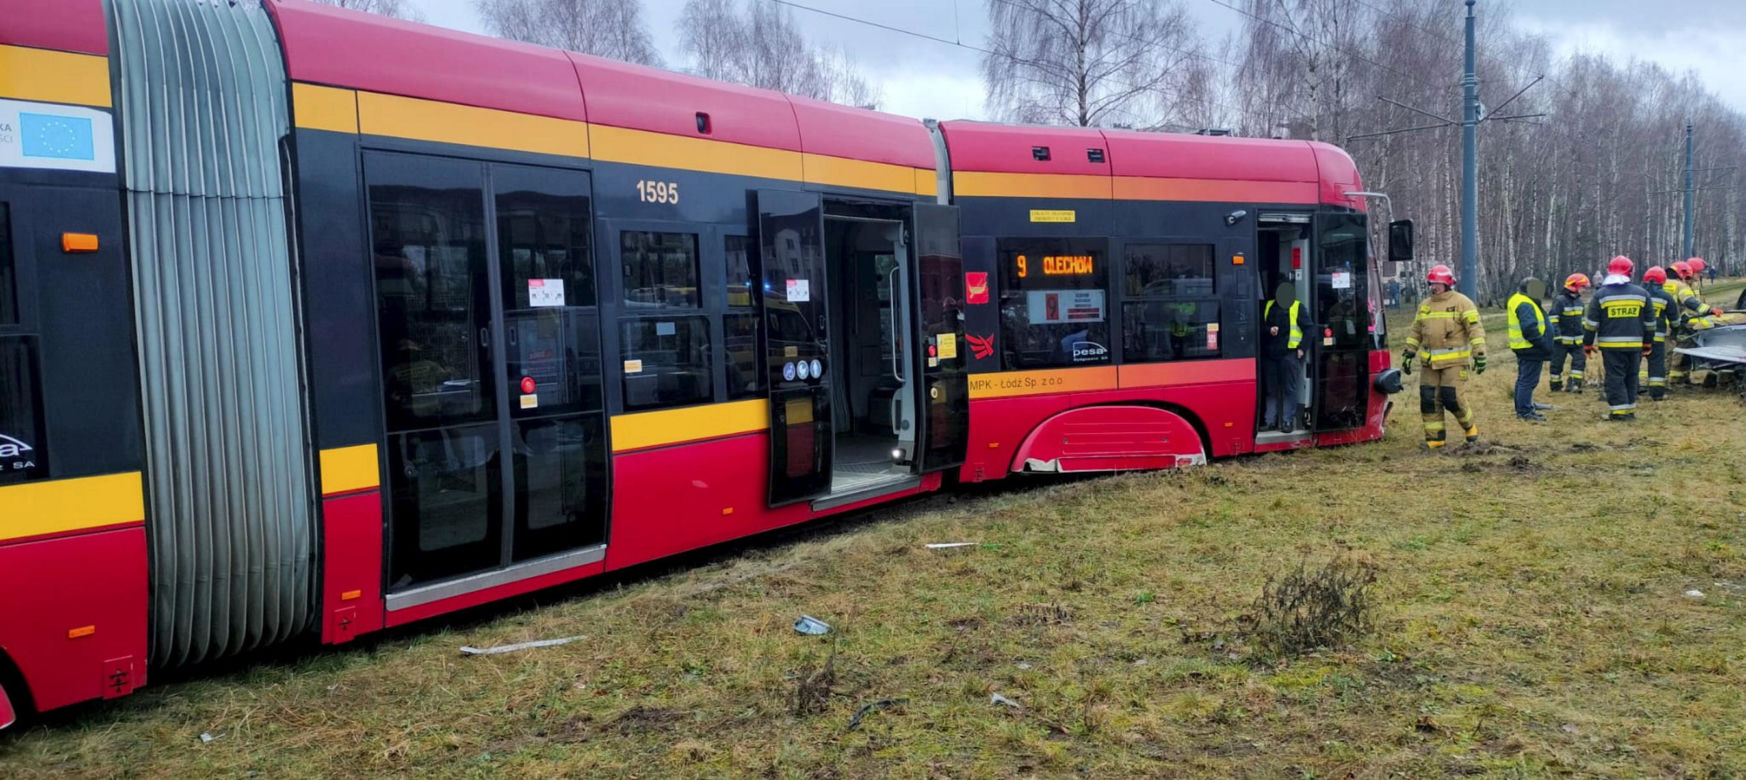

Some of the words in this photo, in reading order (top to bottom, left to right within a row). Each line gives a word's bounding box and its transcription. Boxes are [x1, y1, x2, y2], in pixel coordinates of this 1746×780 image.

[636, 180, 679, 205] 1595
[1017, 255, 1026, 278] 9
[970, 380, 992, 391] MPK
[13, 460, 36, 470] SA
